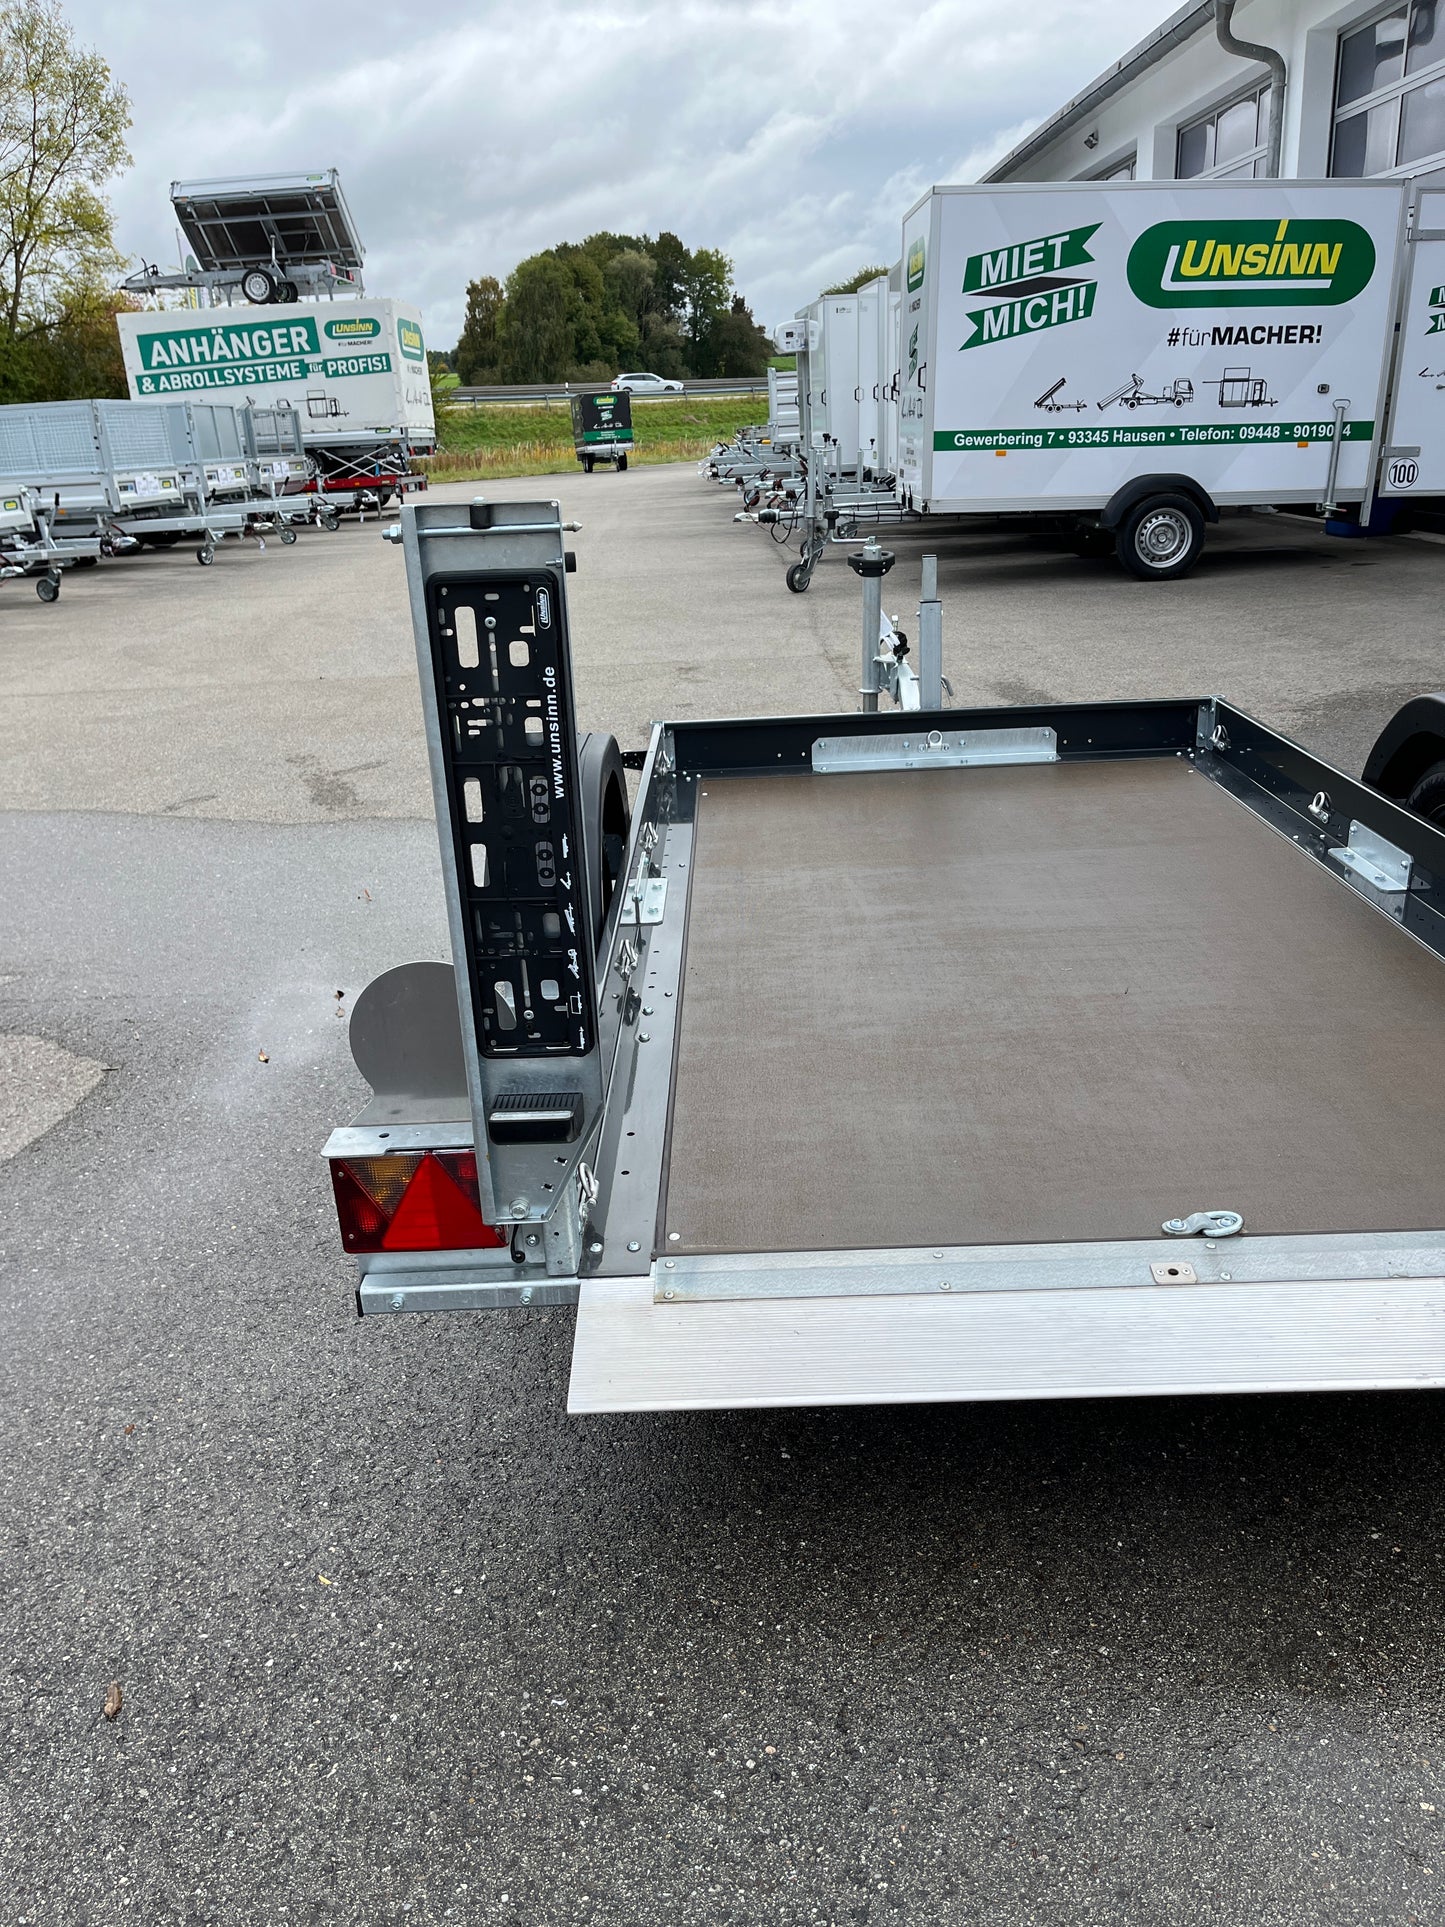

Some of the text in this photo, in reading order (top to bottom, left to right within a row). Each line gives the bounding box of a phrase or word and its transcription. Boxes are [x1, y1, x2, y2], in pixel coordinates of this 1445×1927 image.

[980, 234, 1070, 287] MIET
[1180, 219, 1343, 276] UNSINN
[982, 286, 1087, 341] MICH!
[151, 326, 311, 367] ANHÄNGER
[142, 376, 156, 393] &
[159, 362, 302, 391] ABROLLSYSTEME
[309, 363, 323, 373] für
[327, 355, 388, 376] PROFIS!
[954, 432, 1043, 447] Gewerbering
[1047, 431, 1056, 444] 7
[1068, 430, 1109, 443] 93345
[1112, 430, 1166, 443] Hausen
[1179, 427, 1235, 441] Telefon:
[1239, 425, 1280, 439] 09448
[1293, 424, 1351, 438] 901904
[1393, 464, 1416, 484] 100
[543, 666, 565, 799] www.unsinn.de
